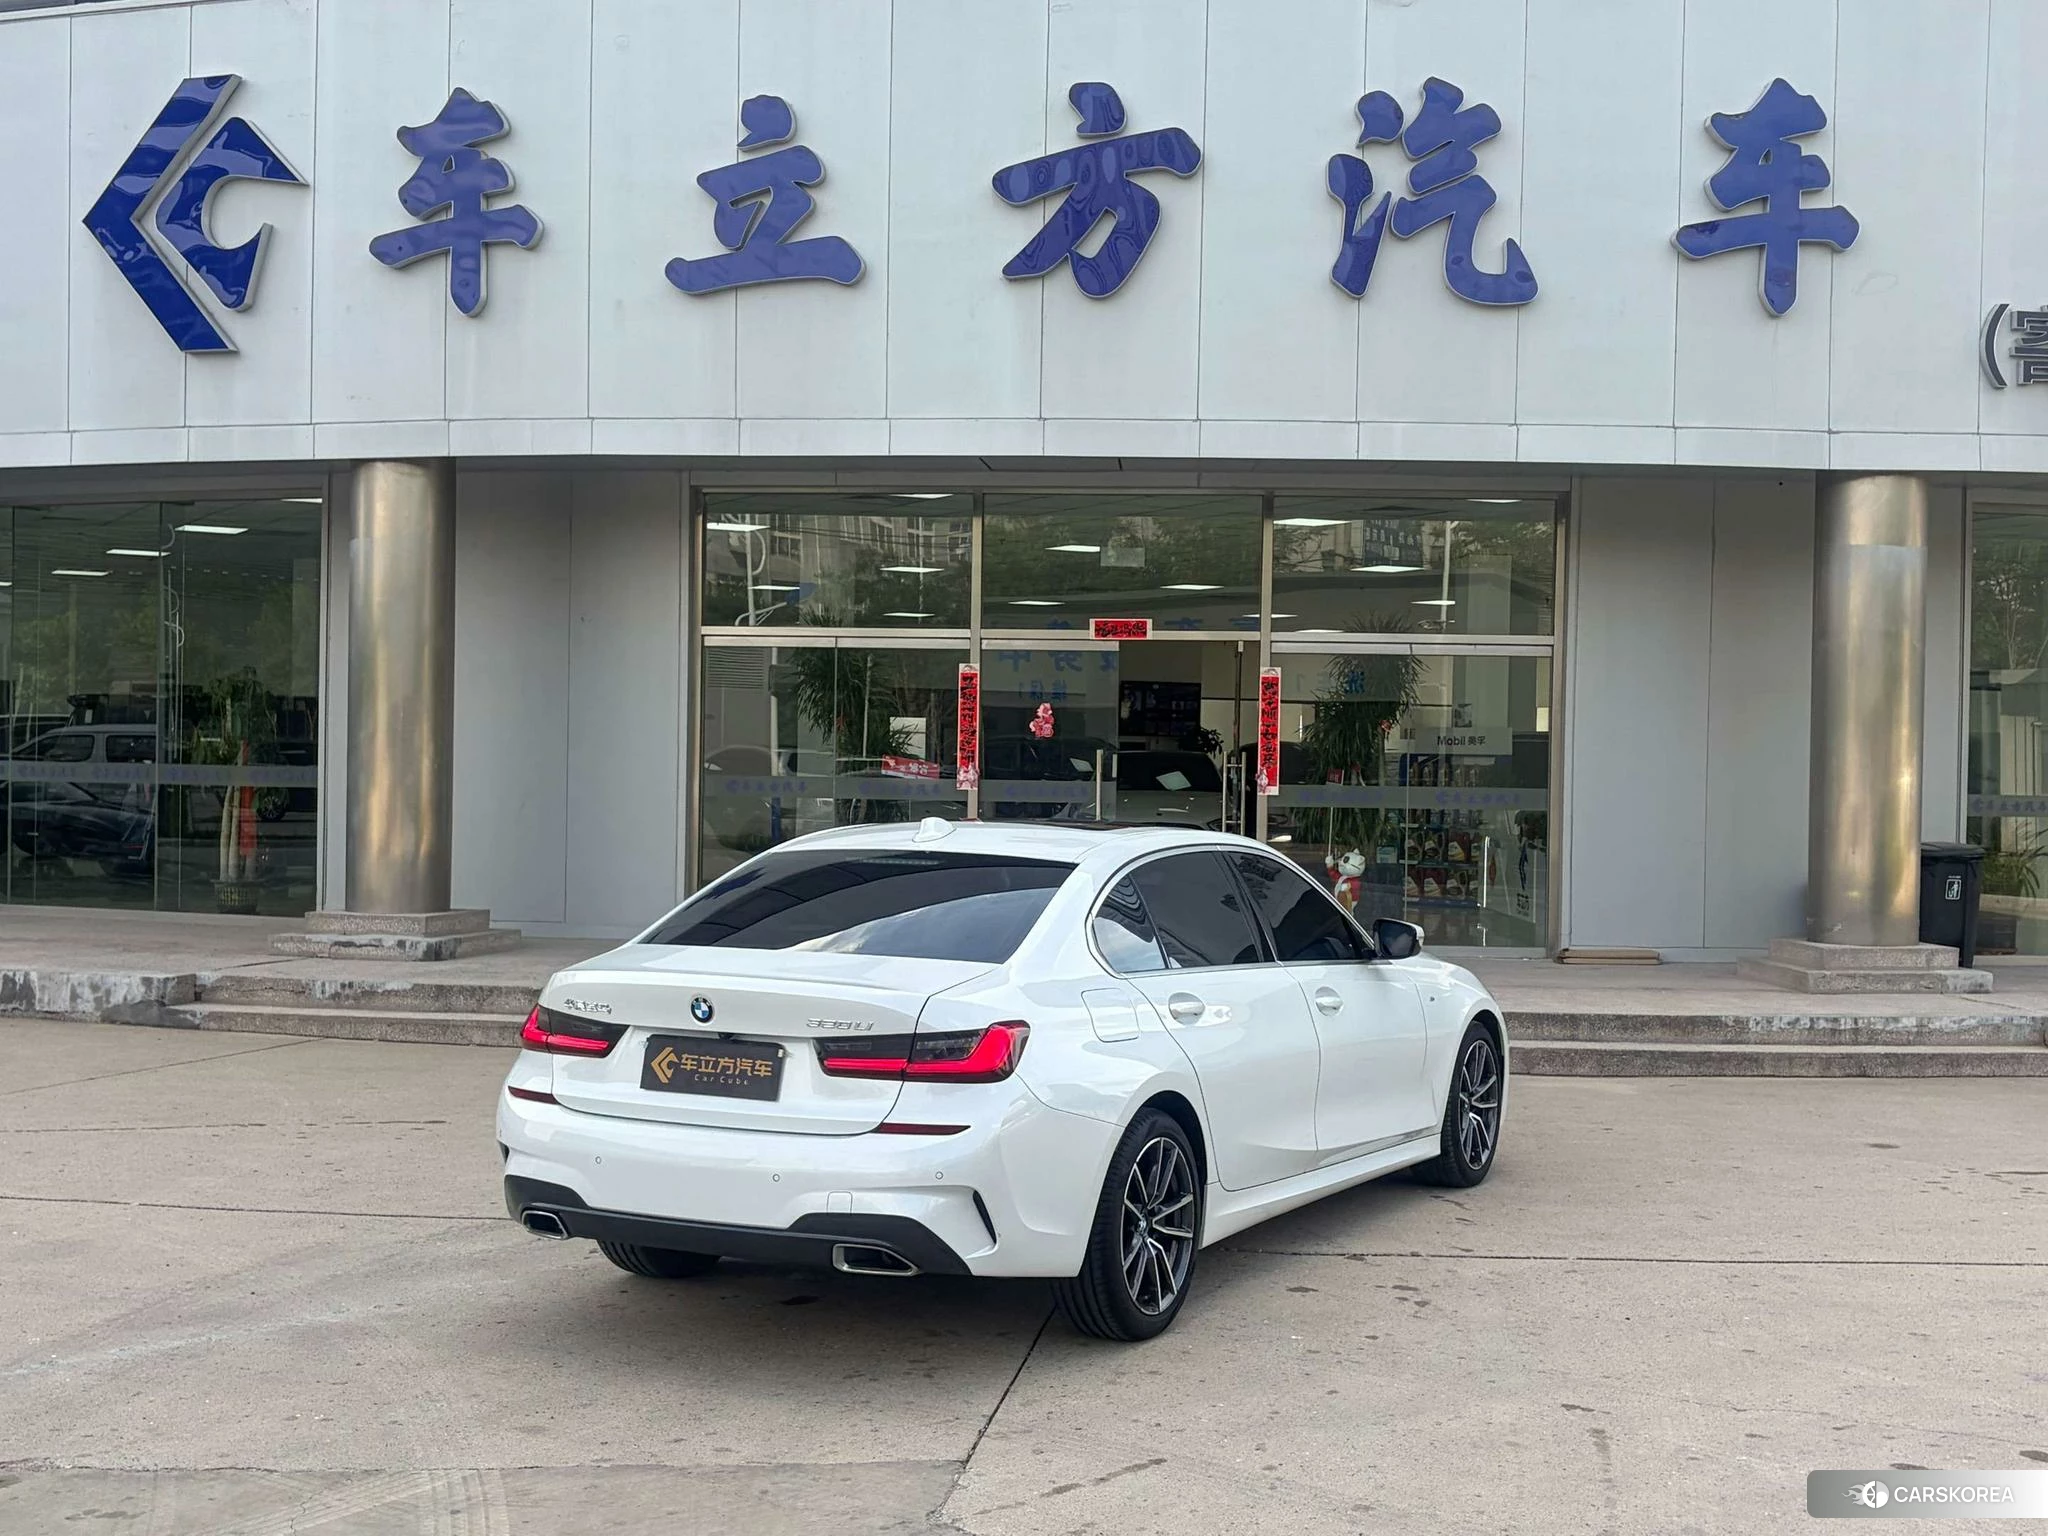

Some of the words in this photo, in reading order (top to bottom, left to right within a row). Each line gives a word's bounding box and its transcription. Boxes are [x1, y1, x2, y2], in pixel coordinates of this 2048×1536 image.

[370, 78, 1860, 316] 车立方汽车
[1437, 736, 1466, 746] Mobil
[680, 1053, 774, 1077] 车立方汽车
[694, 1073, 715, 1083] Car
[720, 1075, 749, 1086] Cube
